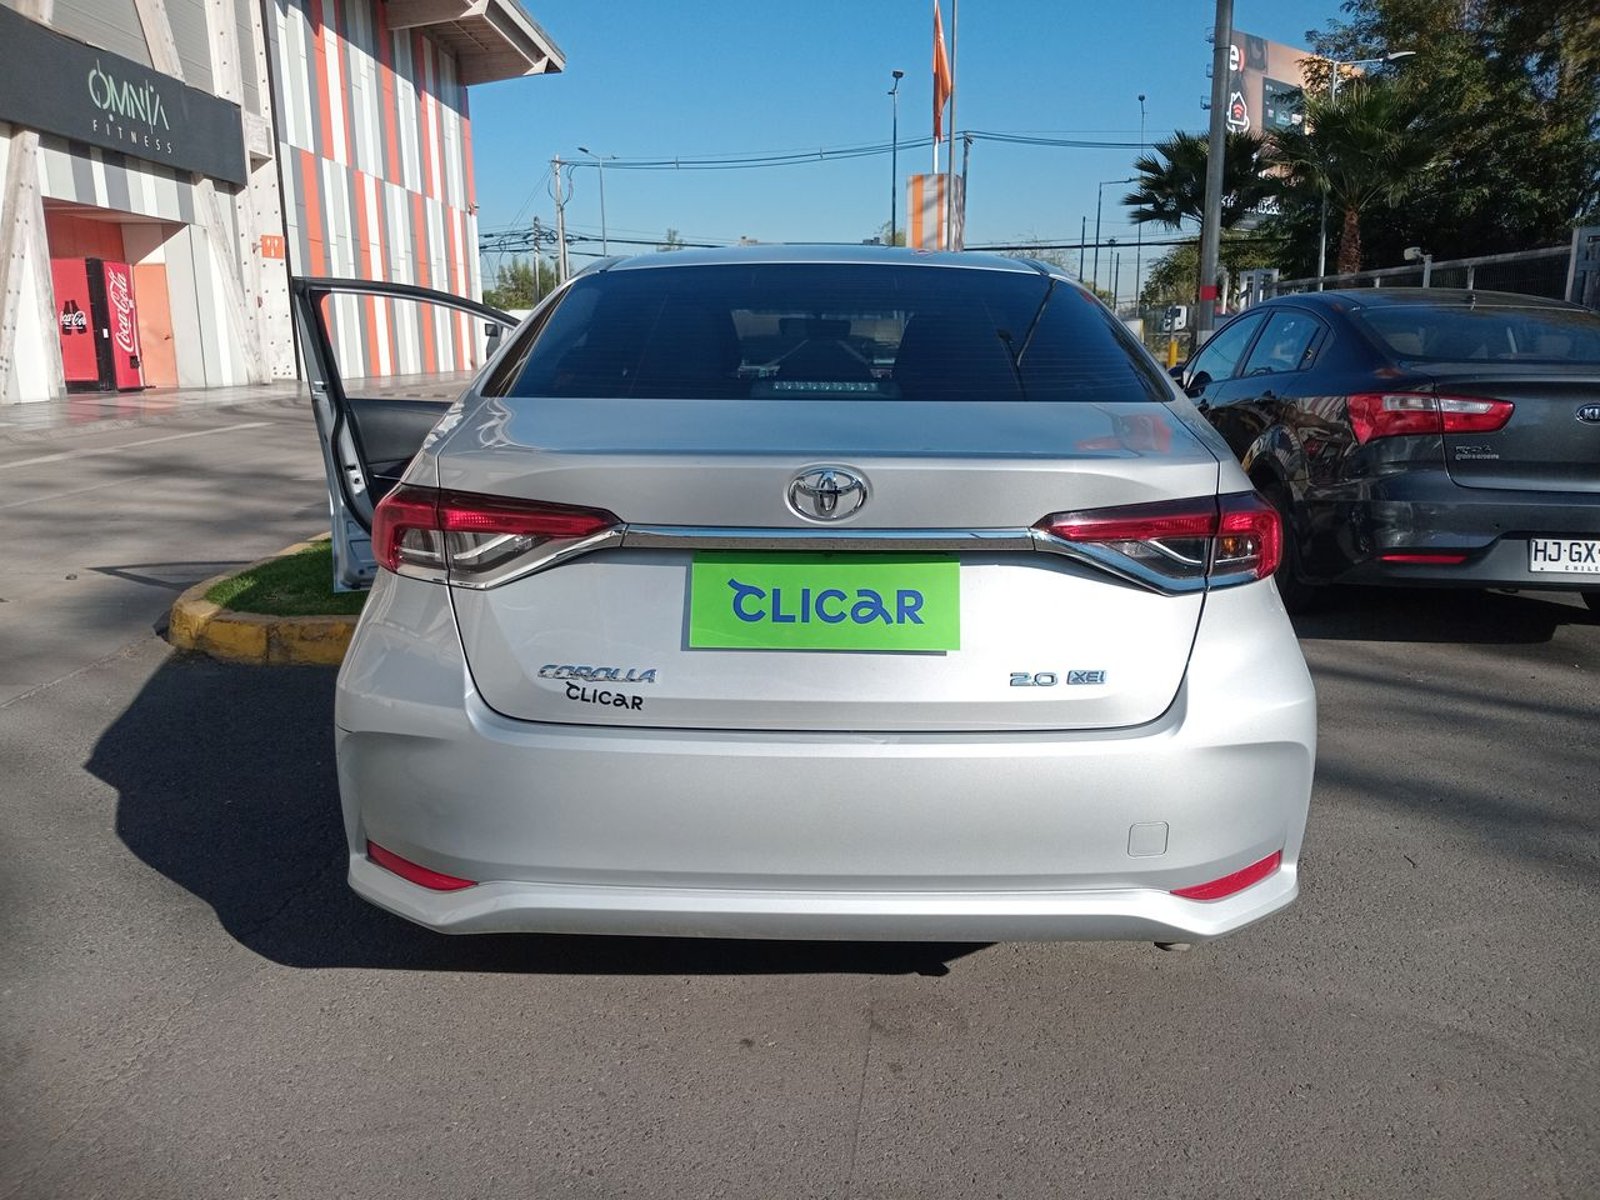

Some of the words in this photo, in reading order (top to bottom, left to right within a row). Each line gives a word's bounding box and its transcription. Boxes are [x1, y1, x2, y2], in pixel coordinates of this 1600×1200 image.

[93, 119, 172, 154] FITNESS
[107, 267, 135, 353] Coca-Cola
[1584, 408, 1600, 420] KI
[538, 664, 657, 683] COROLLA
